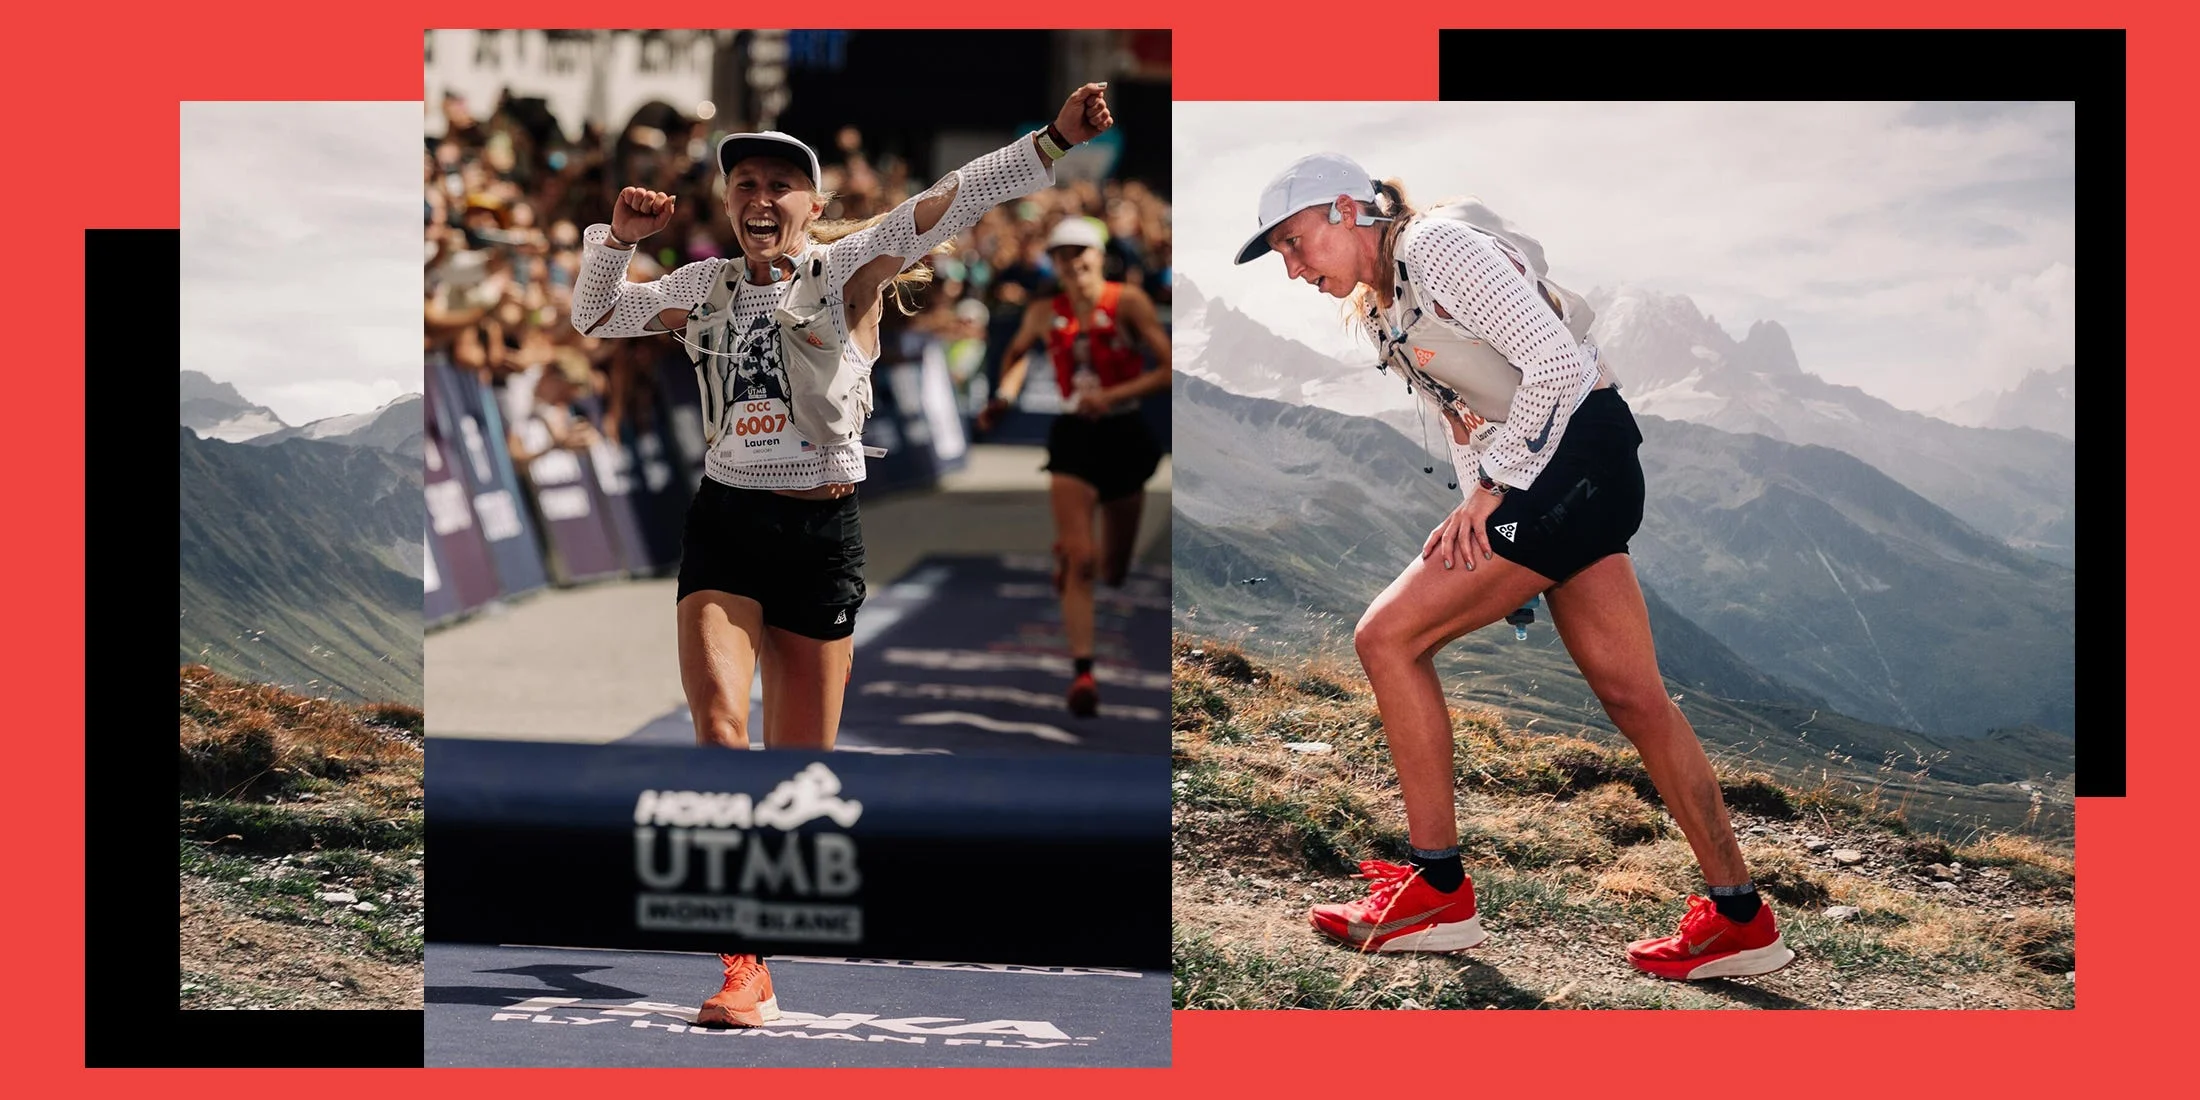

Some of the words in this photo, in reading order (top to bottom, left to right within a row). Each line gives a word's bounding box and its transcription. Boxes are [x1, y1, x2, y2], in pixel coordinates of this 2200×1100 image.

[746, 401, 771, 413] OCC
[735, 413, 788, 437] 6007
[1475, 425, 1497, 441] Lauren
[744, 437, 781, 449] Lauren
[635, 790, 753, 827] HOKA
[636, 828, 861, 893] UTMB
[491, 1013, 618, 1025] FLY
[630, 1019, 927, 1045] HUMAN
[944, 1038, 1069, 1049] FLY
